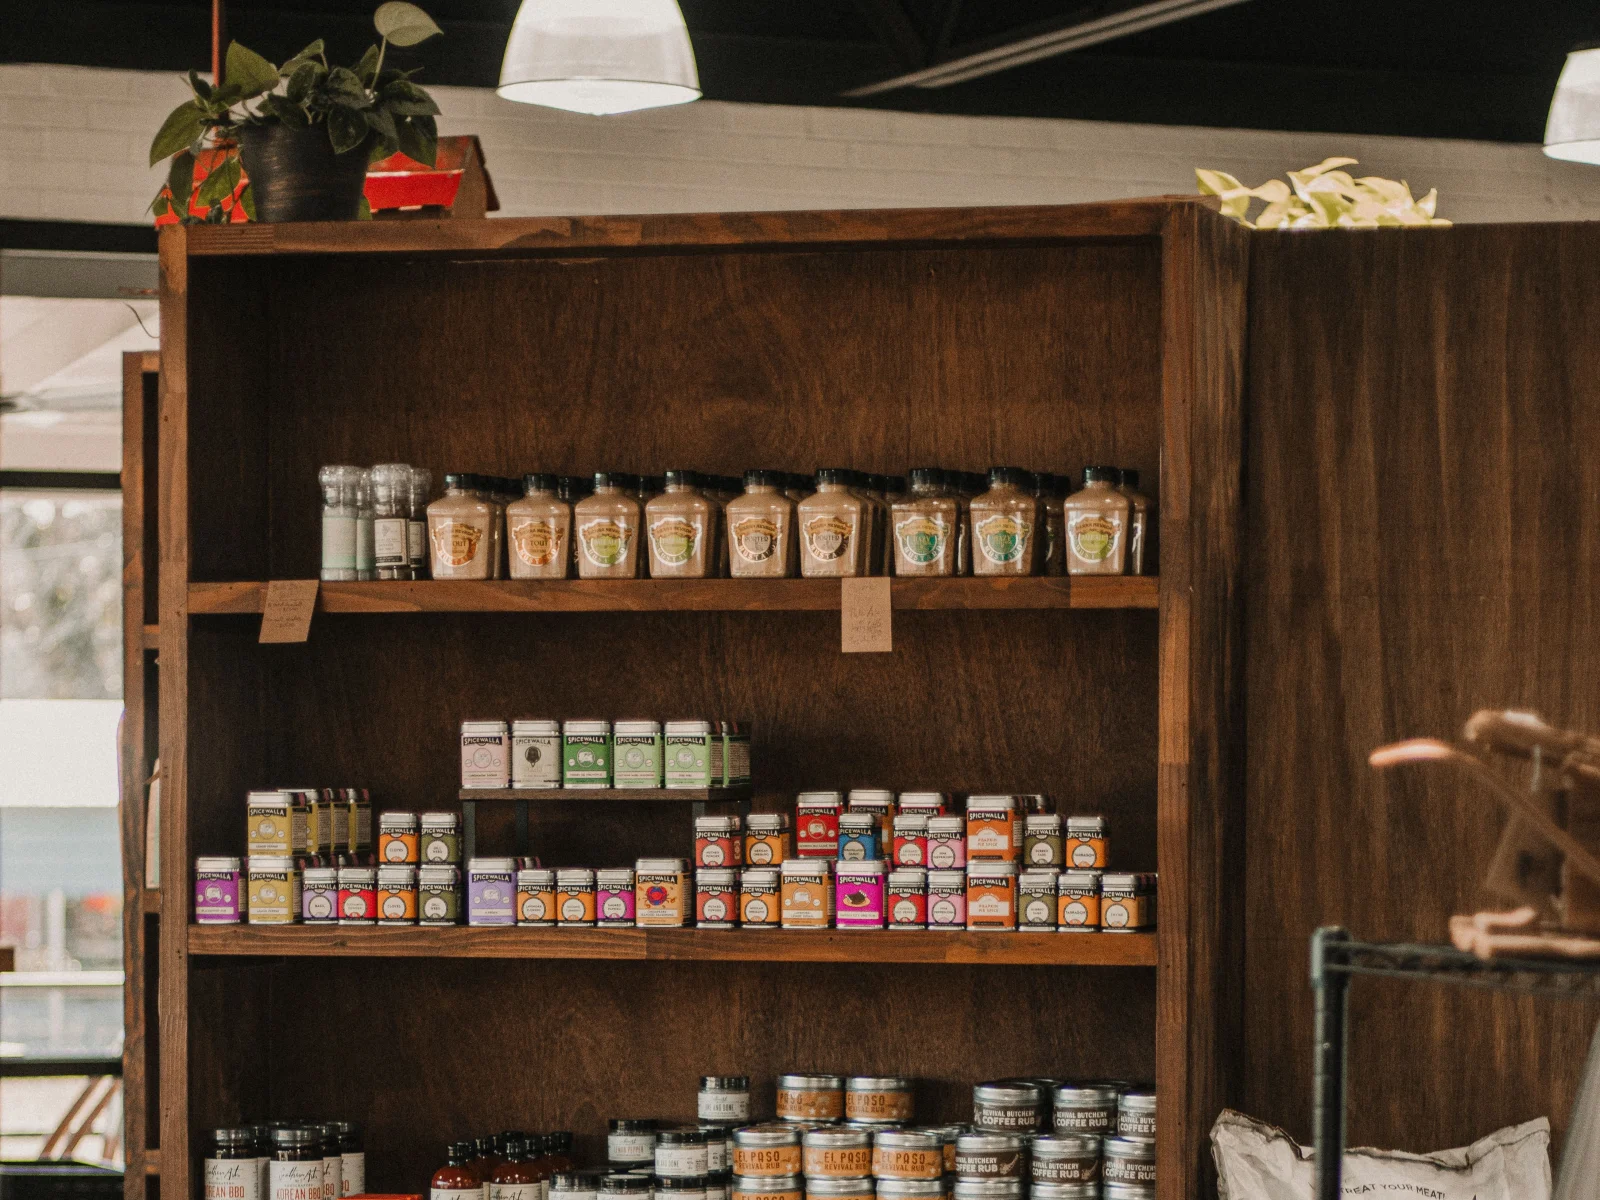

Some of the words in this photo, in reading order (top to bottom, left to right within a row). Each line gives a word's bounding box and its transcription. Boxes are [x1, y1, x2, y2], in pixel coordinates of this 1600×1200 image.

[463, 737, 501, 746] SPICEWALLA
[515, 738, 552, 746] SPICEWALLA
[568, 736, 604, 745] SPICEWALLA
[616, 737, 654, 746] SPICEWALLA
[666, 737, 703, 746] SPICEWALLA
[250, 808, 285, 816] SPICEWALLA
[969, 813, 1006, 821] SPICEWALLA
[780, 1094, 802, 1105] PASO
[848, 1095, 857, 1105] EL
[860, 1095, 885, 1106] PASO
[982, 1117, 1016, 1126] COFFEE
[1018, 1117, 1035, 1126] RUB
[1056, 1118, 1086, 1127] COFFEE
[1089, 1118, 1108, 1127] RUB
[1120, 1123, 1149, 1133] COFFEE
[738, 1151, 748, 1162] EL
[750, 1151, 780, 1162] PASO
[824, 1151, 836, 1163] EL
[840, 1152, 867, 1164] PASO
[882, 1151, 891, 1163] EL
[896, 1153, 925, 1165] PASO
[970, 1157, 997, 1165] BUTCHERY
[956, 1163, 976, 1172] OFFEE
[977, 1163, 998, 1172] RUB
[1049, 1162, 1079, 1170] BUTCHERY
[1127, 1163, 1156, 1172] BUTCHER
[1032, 1168, 1057, 1178] COFFEE
[1060, 1170, 1080, 1178] RUB
[1105, 1170, 1136, 1179] COFFEE
[206, 1186, 226, 1198] REAN
[228, 1186, 245, 1199] BBQ
[277, 1189, 305, 1200] KOREAN
[308, 1187, 320, 1199] BBQ
[1380, 1184, 1413, 1192] YOUR
[1416, 1186, 1446, 1200] MEAT!
